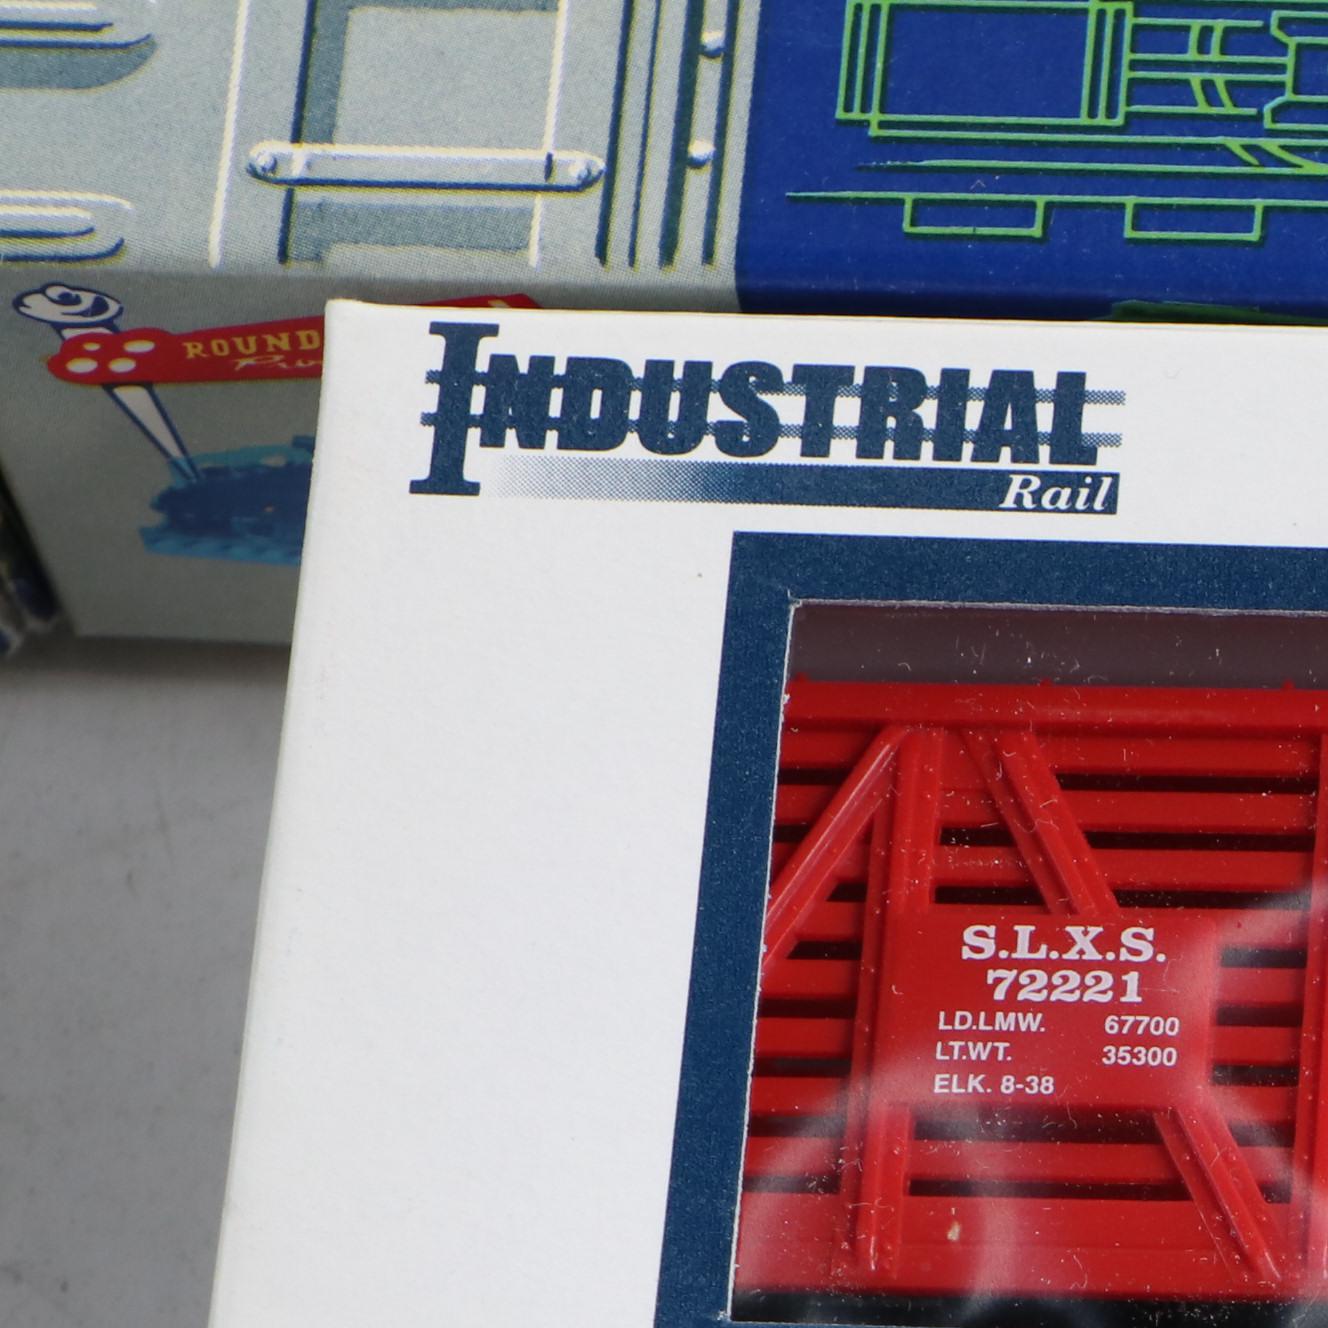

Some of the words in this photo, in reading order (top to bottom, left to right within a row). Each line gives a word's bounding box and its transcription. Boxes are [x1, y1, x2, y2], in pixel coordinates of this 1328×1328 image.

[409, 320, 1100, 496] INDUSTRIAL
[1000, 473, 1111, 513] Rail
[960, 923, 1168, 963] S.L.X.S.
[985, 968, 1144, 1004] 72221
[937, 1010, 1047, 1033] LD.LMW.
[1103, 1014, 1181, 1037] 67700
[934, 1040, 1014, 1063] LT.WT.
[1100, 1044, 1178, 1067] 35300
[932, 1072, 993, 1095] ELK.
[999, 1073, 1056, 1095] 8-38
